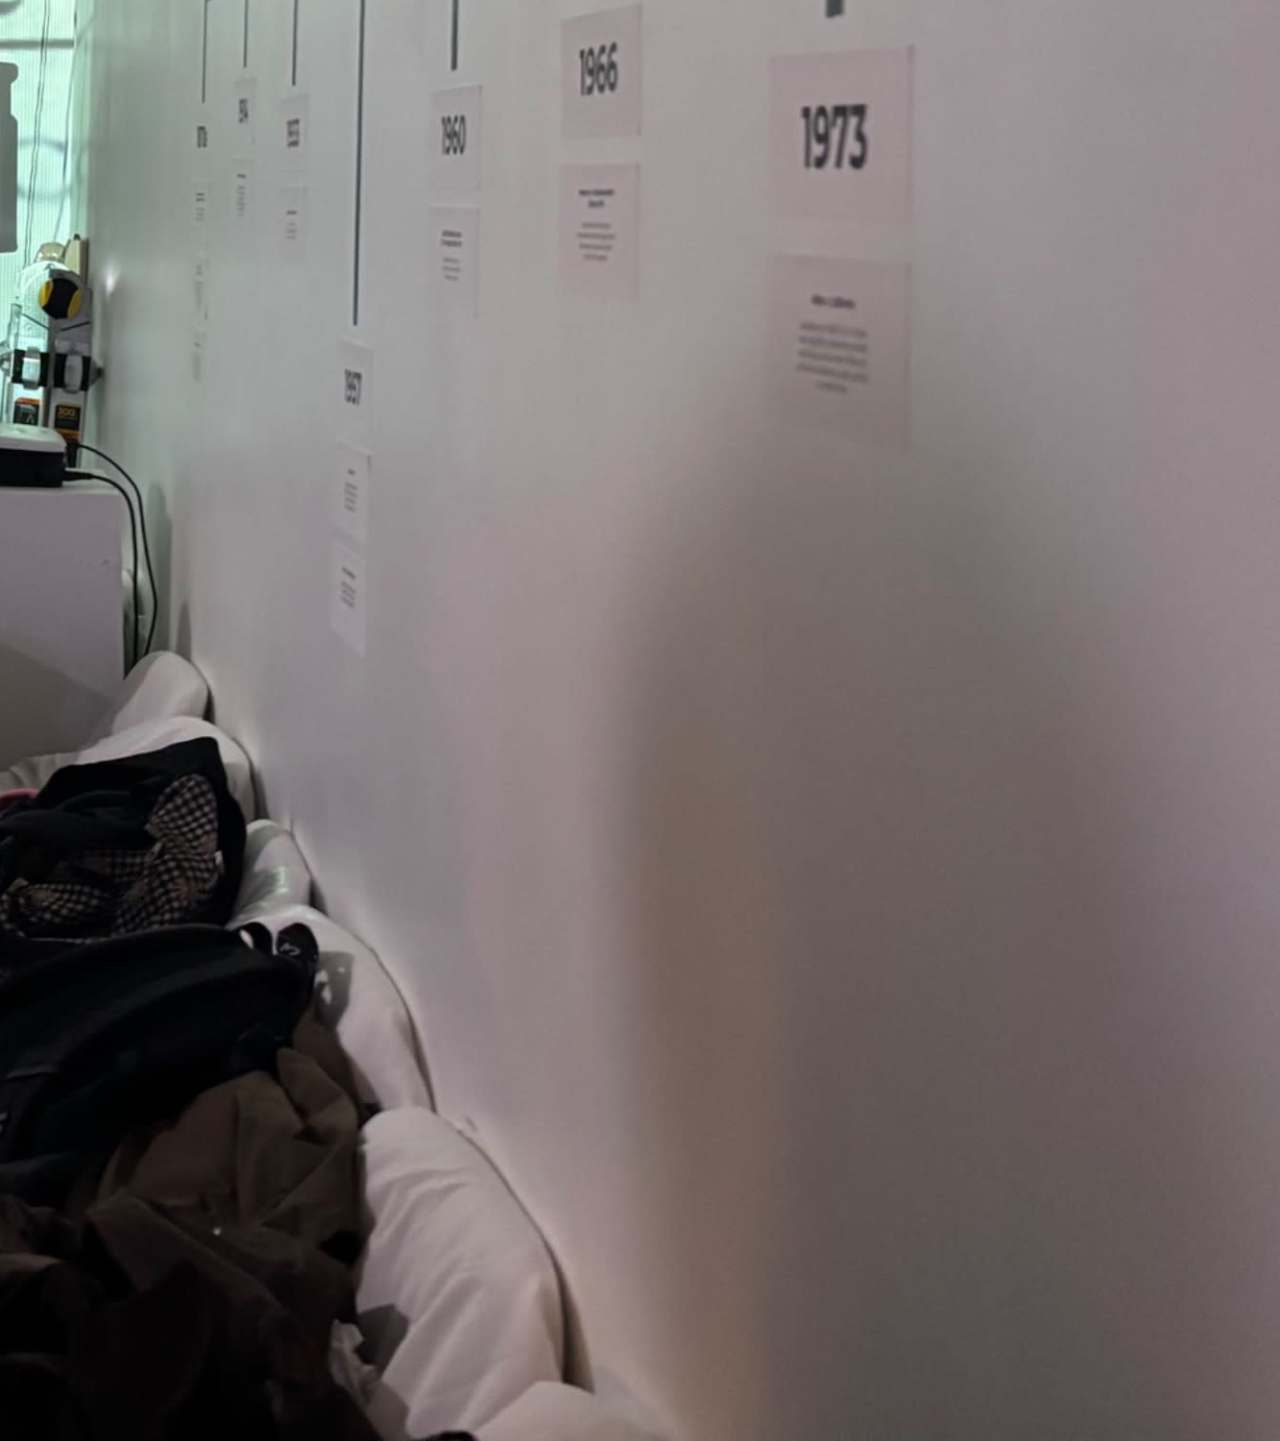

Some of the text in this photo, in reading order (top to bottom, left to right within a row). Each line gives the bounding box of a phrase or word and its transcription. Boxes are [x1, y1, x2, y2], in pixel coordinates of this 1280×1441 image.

[579, 42, 619, 97] 1966
[442, 114, 467, 156] 1960
[801, 104, 868, 170] 1973
